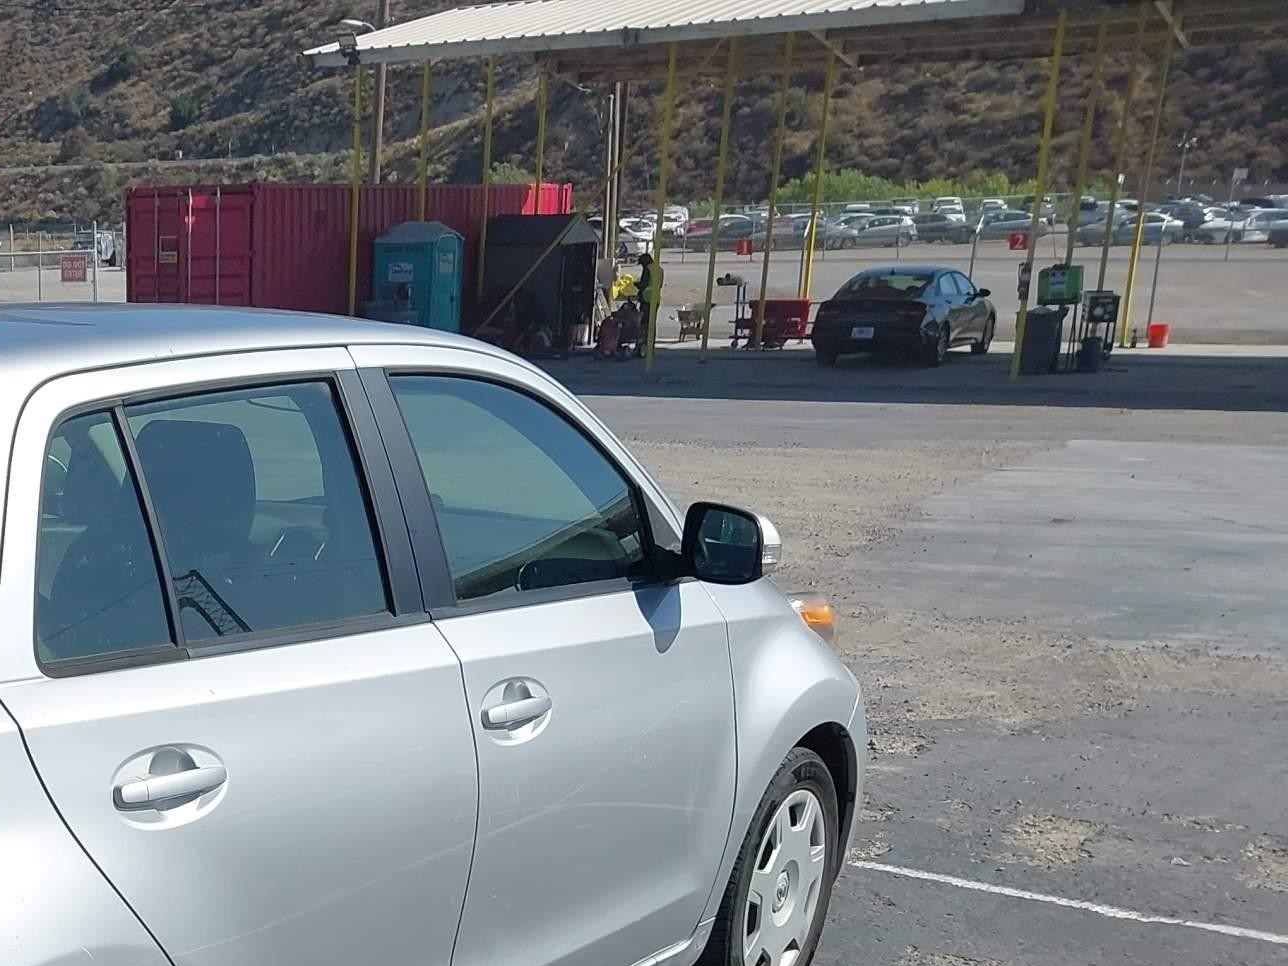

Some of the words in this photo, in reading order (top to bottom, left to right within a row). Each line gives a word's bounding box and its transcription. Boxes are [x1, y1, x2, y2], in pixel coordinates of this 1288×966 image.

[1014, 234, 1024, 249] 2
[62, 261, 72, 270] DO
[73, 261, 85, 270] NOT
